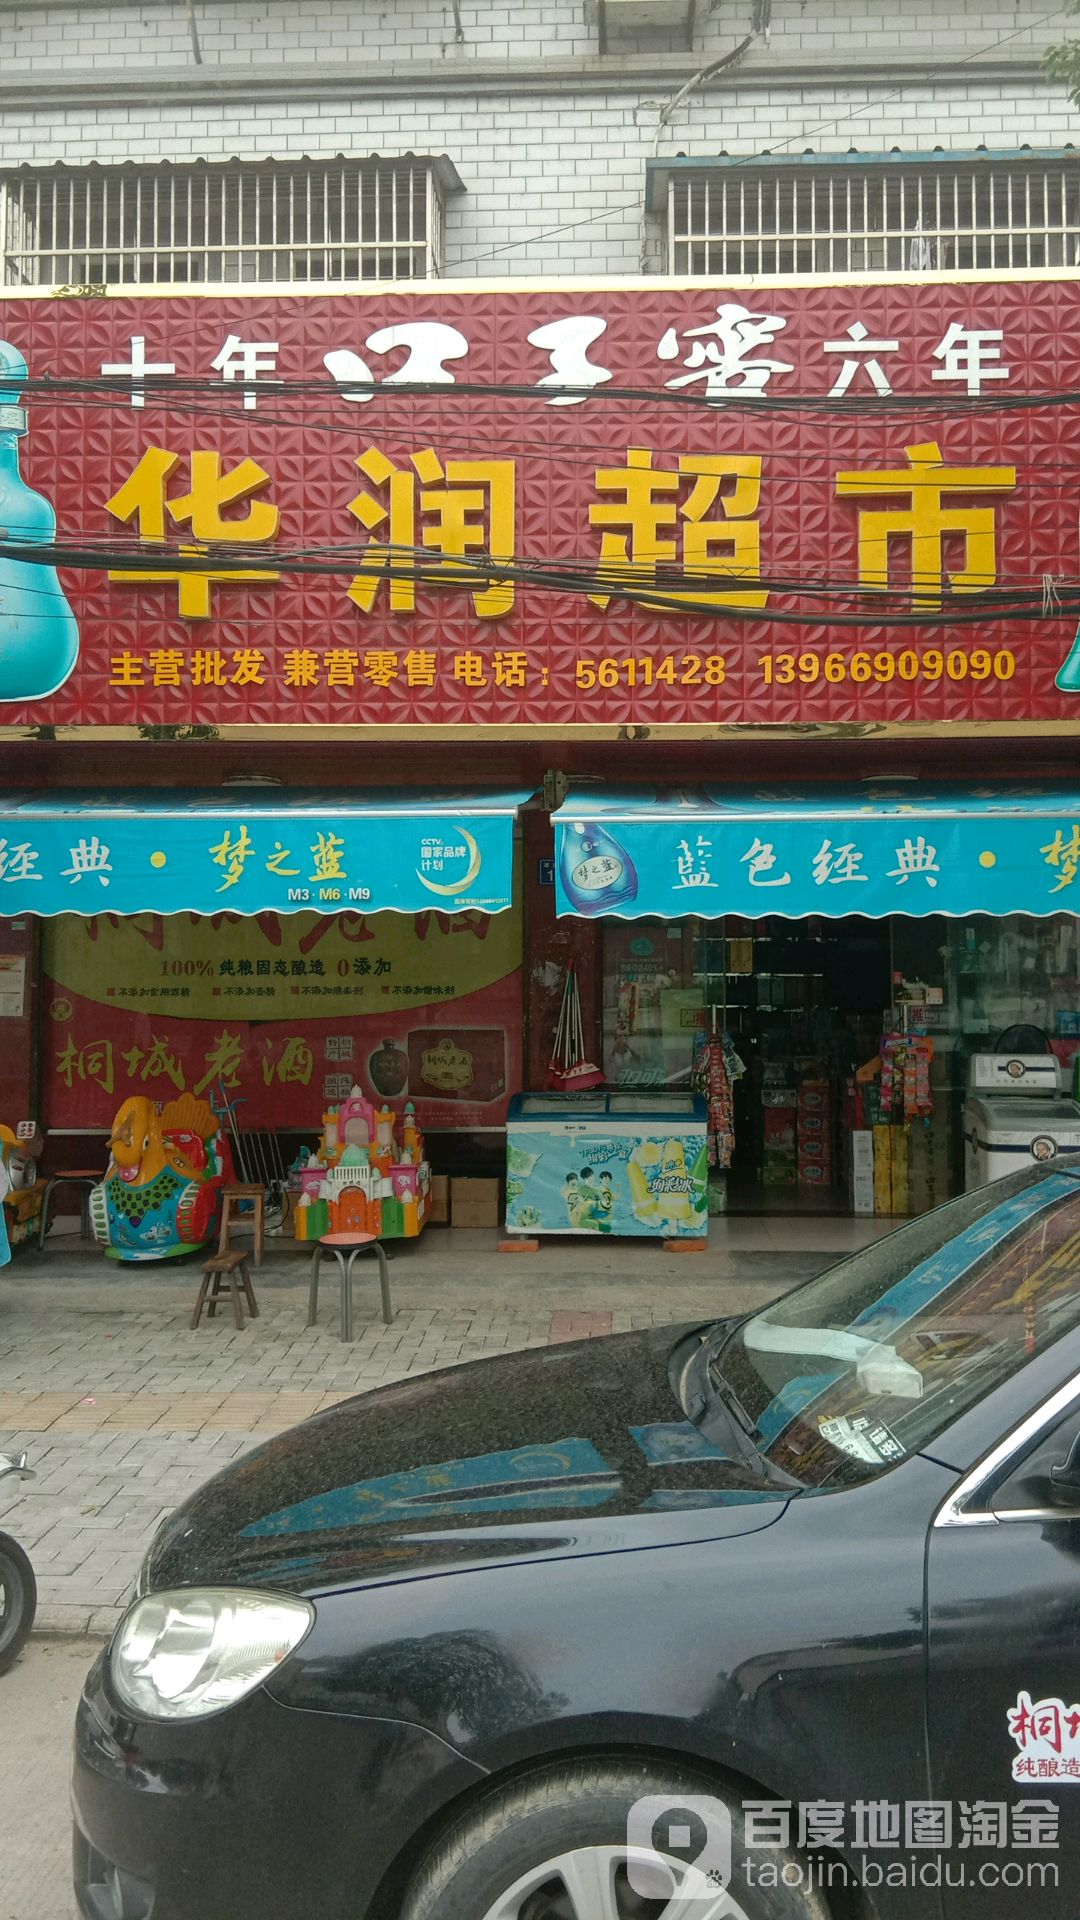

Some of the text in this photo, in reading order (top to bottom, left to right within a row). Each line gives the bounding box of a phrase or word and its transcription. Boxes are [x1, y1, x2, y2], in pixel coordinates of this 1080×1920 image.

[101, 335, 284, 410] 十年
[823, 320, 1009, 397] 六年
[104, 442, 1016, 619] 华润超市
[109, 649, 266, 687] 主营批发
[283, 650, 437, 687] 兼营零售
[757, 649, 1016, 684] 13966909090
[421, 846, 466, 858] 国家品牌
[421, 859, 443, 871] 计划
[160, 959, 214, 977] 100%
[219, 958, 326, 977] 纯粮固态酿造
[56, 1028, 314, 1096] 桐城老酒
[1015, 1757, 1080, 1778] 纯酿造
